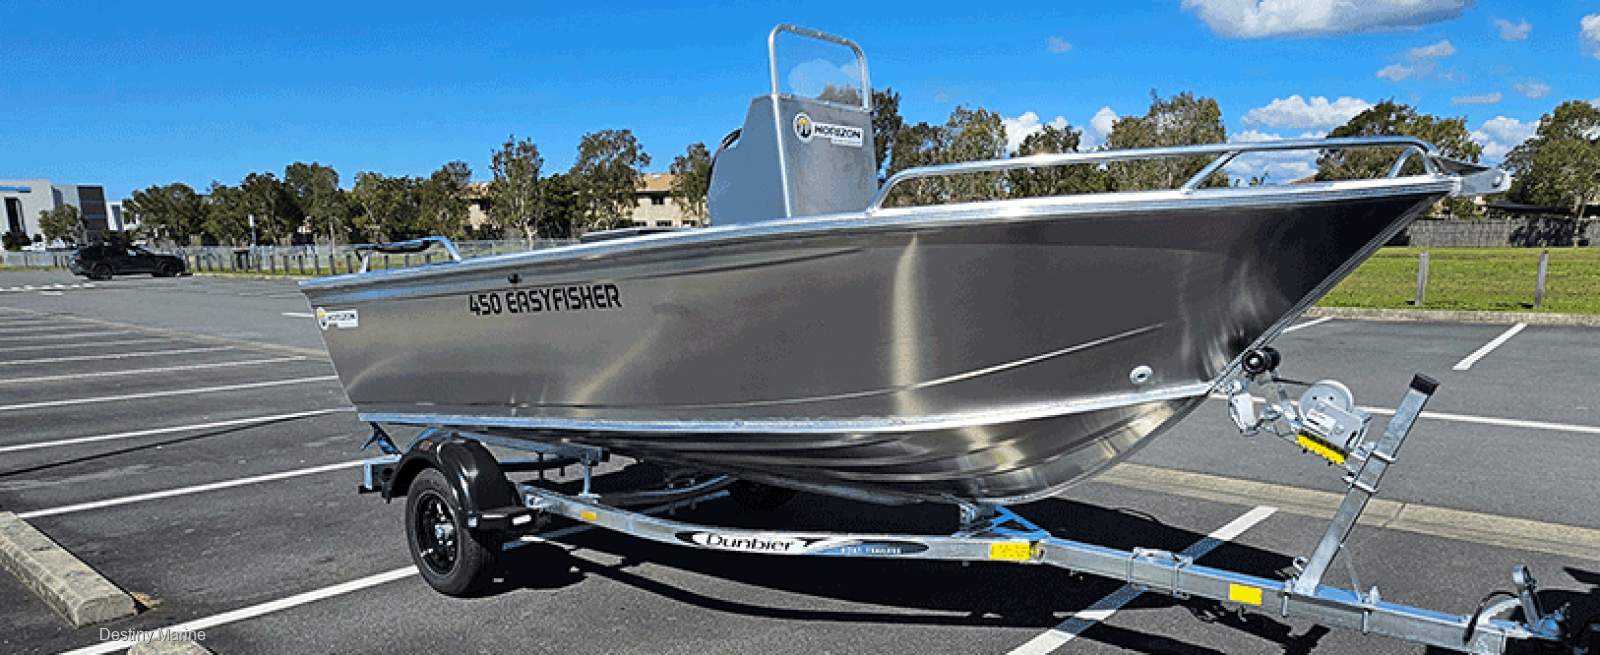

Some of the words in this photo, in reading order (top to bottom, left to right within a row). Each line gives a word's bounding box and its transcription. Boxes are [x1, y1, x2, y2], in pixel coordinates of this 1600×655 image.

[815, 125, 861, 138] HORIZON
[470, 293, 502, 315] 450
[506, 284, 622, 313] EASYFISHER
[706, 532, 794, 552] Dunbier
